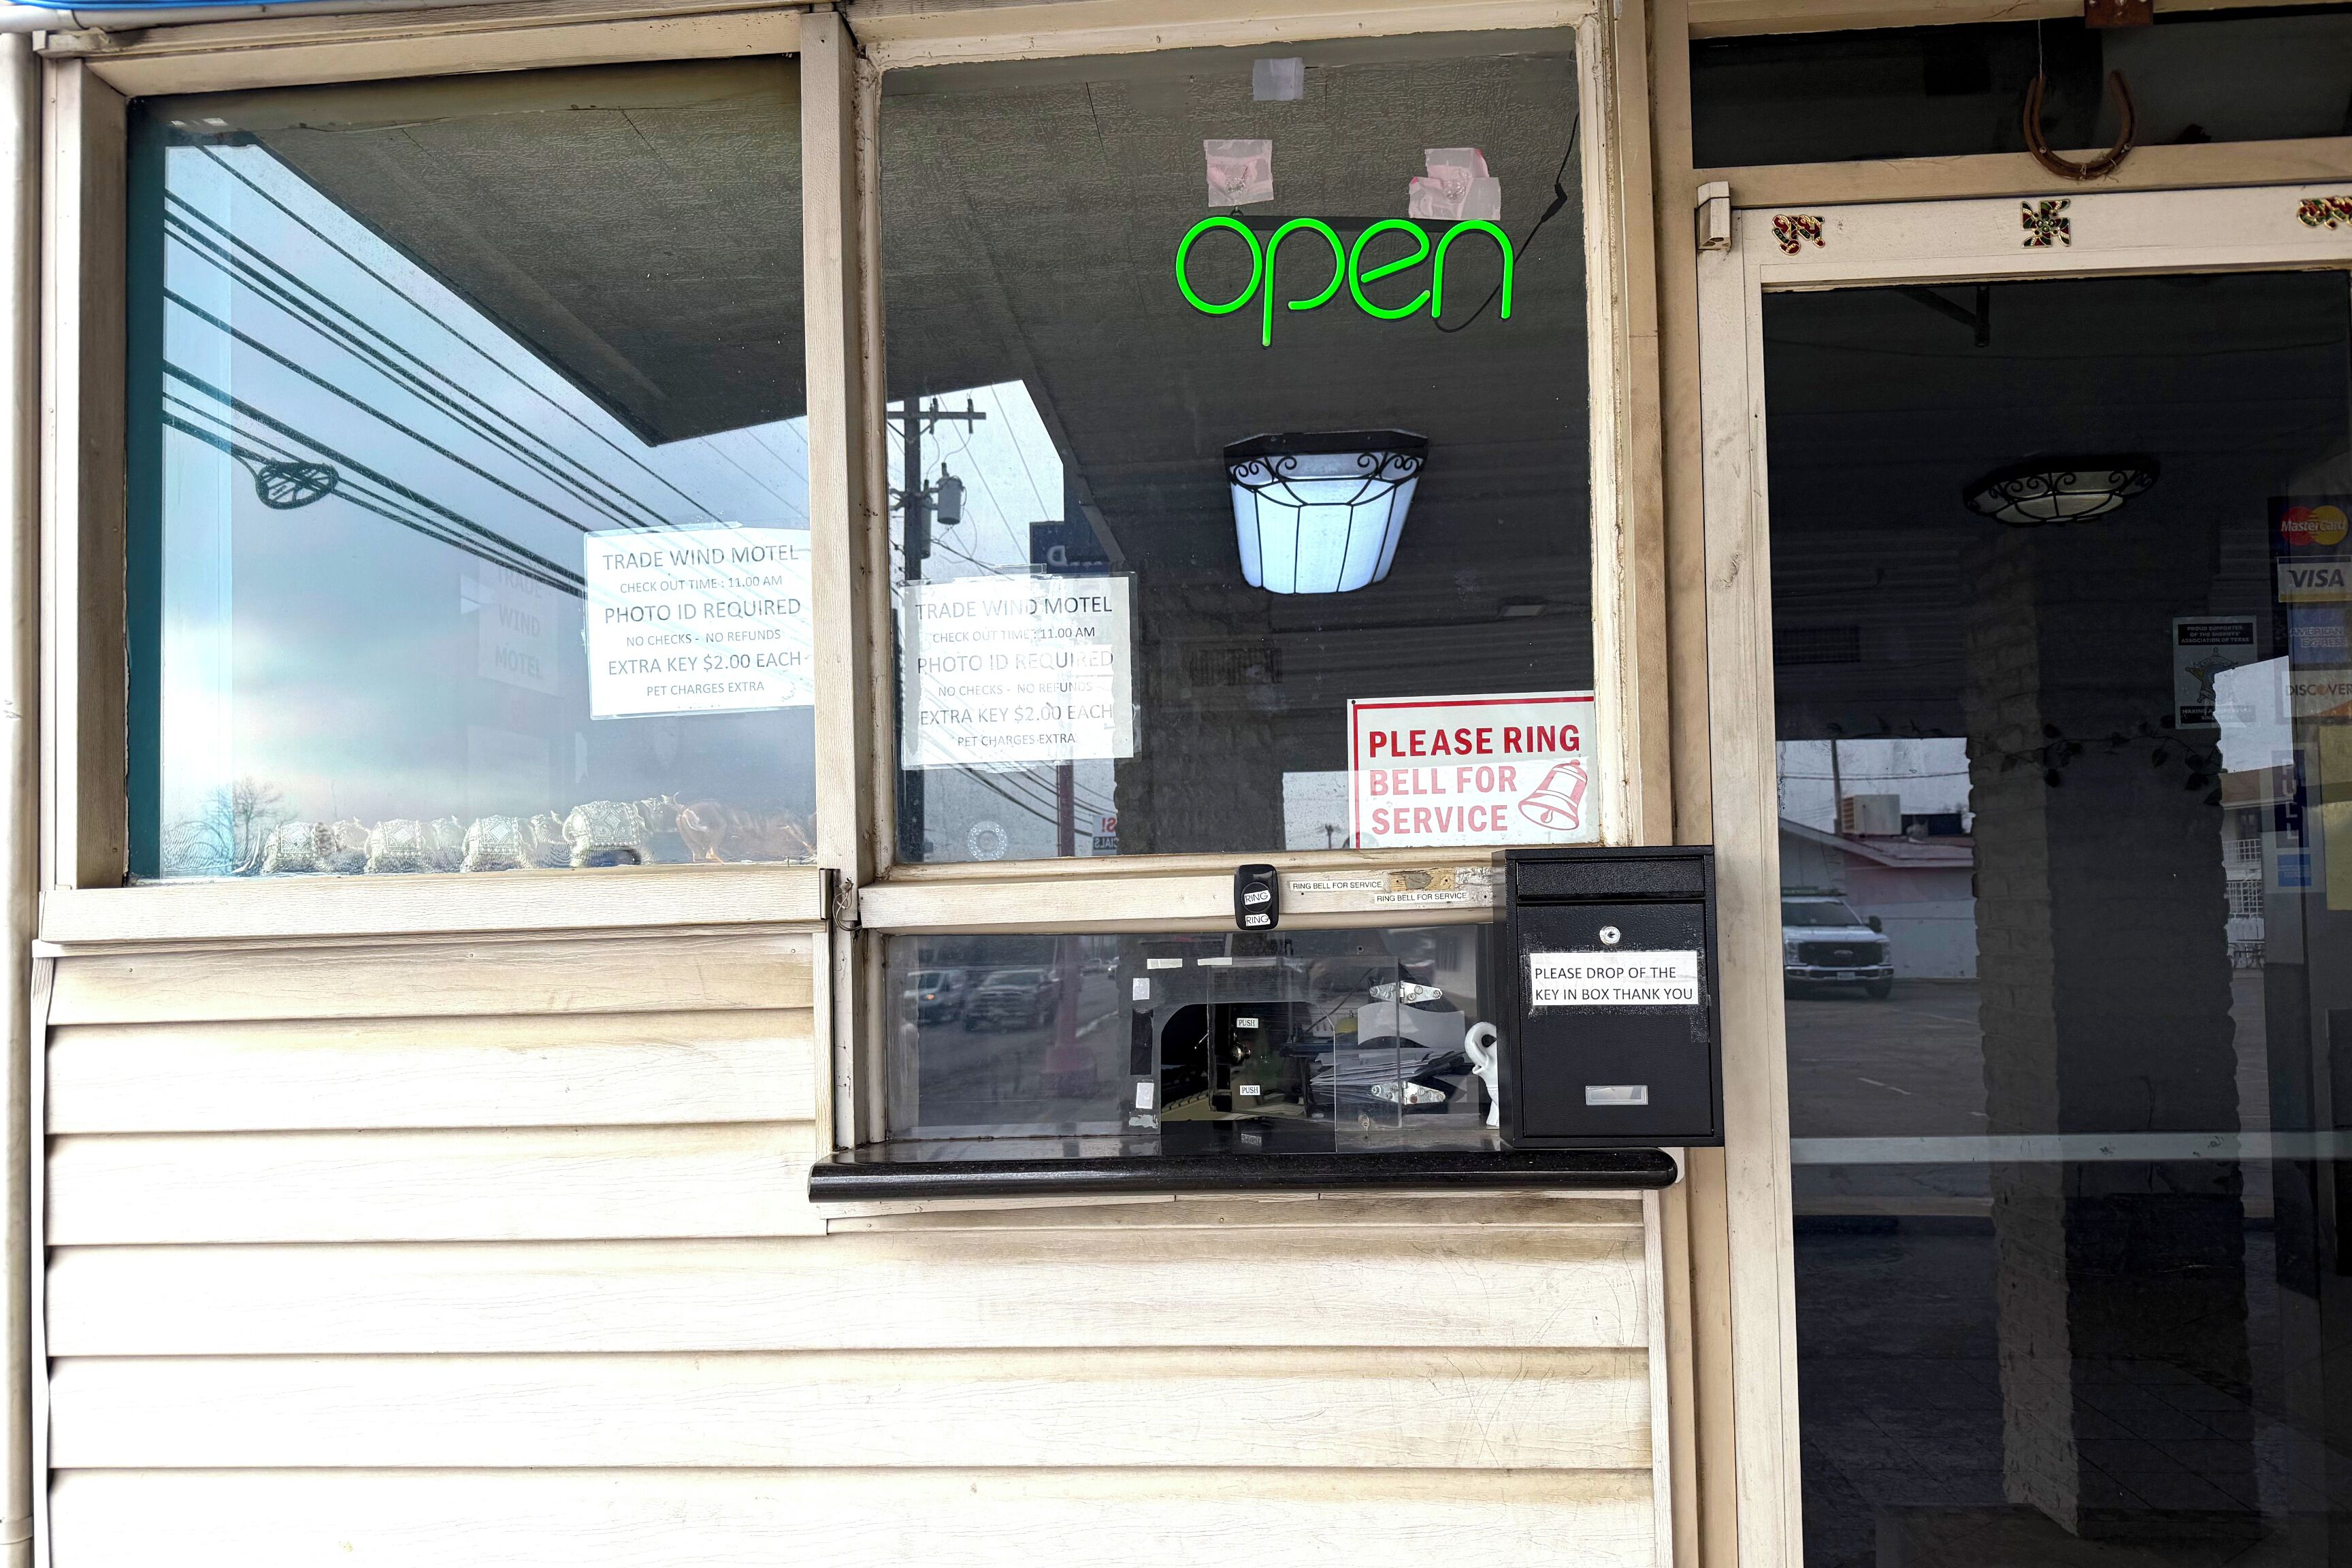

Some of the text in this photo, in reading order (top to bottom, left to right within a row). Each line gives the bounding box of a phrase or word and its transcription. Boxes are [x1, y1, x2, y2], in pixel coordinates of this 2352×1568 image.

[1175, 216, 1514, 347] open
[2281, 519, 2347, 532] MasterCard
[603, 544, 799, 570] TRADE WIND MOTEL
[620, 581, 657, 593] CHECK
[661, 580, 685, 591] OUT
[689, 578, 719, 590] TIME
[728, 576, 760, 588] 11.00
[763, 576, 783, 587] AM
[2287, 569, 2345, 588] VISA
[604, 598, 801, 624] PHOTO ID REQUIRED
[915, 596, 1113, 620] TRADE WIND MOTEL
[627, 634, 644, 647] NO
[649, 634, 692, 647] CHECKS
[706, 632, 723, 643] NO
[728, 630, 781, 642] REFUNDS
[933, 632, 968, 643] CHECK
[973, 630, 997, 642] OUT
[1001, 630, 1029, 640] TIME
[1040, 627, 1073, 639] 11.00
[1075, 627, 1095, 638] AM
[2289, 627, 2345, 637] AMERICAN
[2301, 638, 2347, 647] EXPRESS
[608, 651, 802, 676] EXTRA KEY $2.00 EACH
[917, 651, 1113, 674] PHOTO ID REQUIRED
[647, 681, 764, 697] PET CHARGES EXTRA
[938, 685, 956, 697] NO
[960, 684, 1003, 696] CHECKS
[1017, 683, 1034, 694] NO
[1039, 682, 1092, 693] REFUNDS
[920, 704, 1113, 725] EXTRA KEY $2.00 EACH
[958, 732, 1076, 747] PET CHARGES EXTRA
[1369, 724, 1580, 757] PLEASE RING
[1370, 766, 1518, 796] BELL FOR
[1372, 804, 1508, 835] SERVICE
[1350, 881, 1382, 889] SERVICE
[1244, 891, 1269, 903] RING
[1377, 892, 1467, 902] RING BELL FOR SERVICE
[1246, 914, 1269, 924] RING
[1535, 967, 1676, 979] PLEASE DROP OF THE
[1535, 988, 1693, 1000] KEY IN BOX THANK YOU
